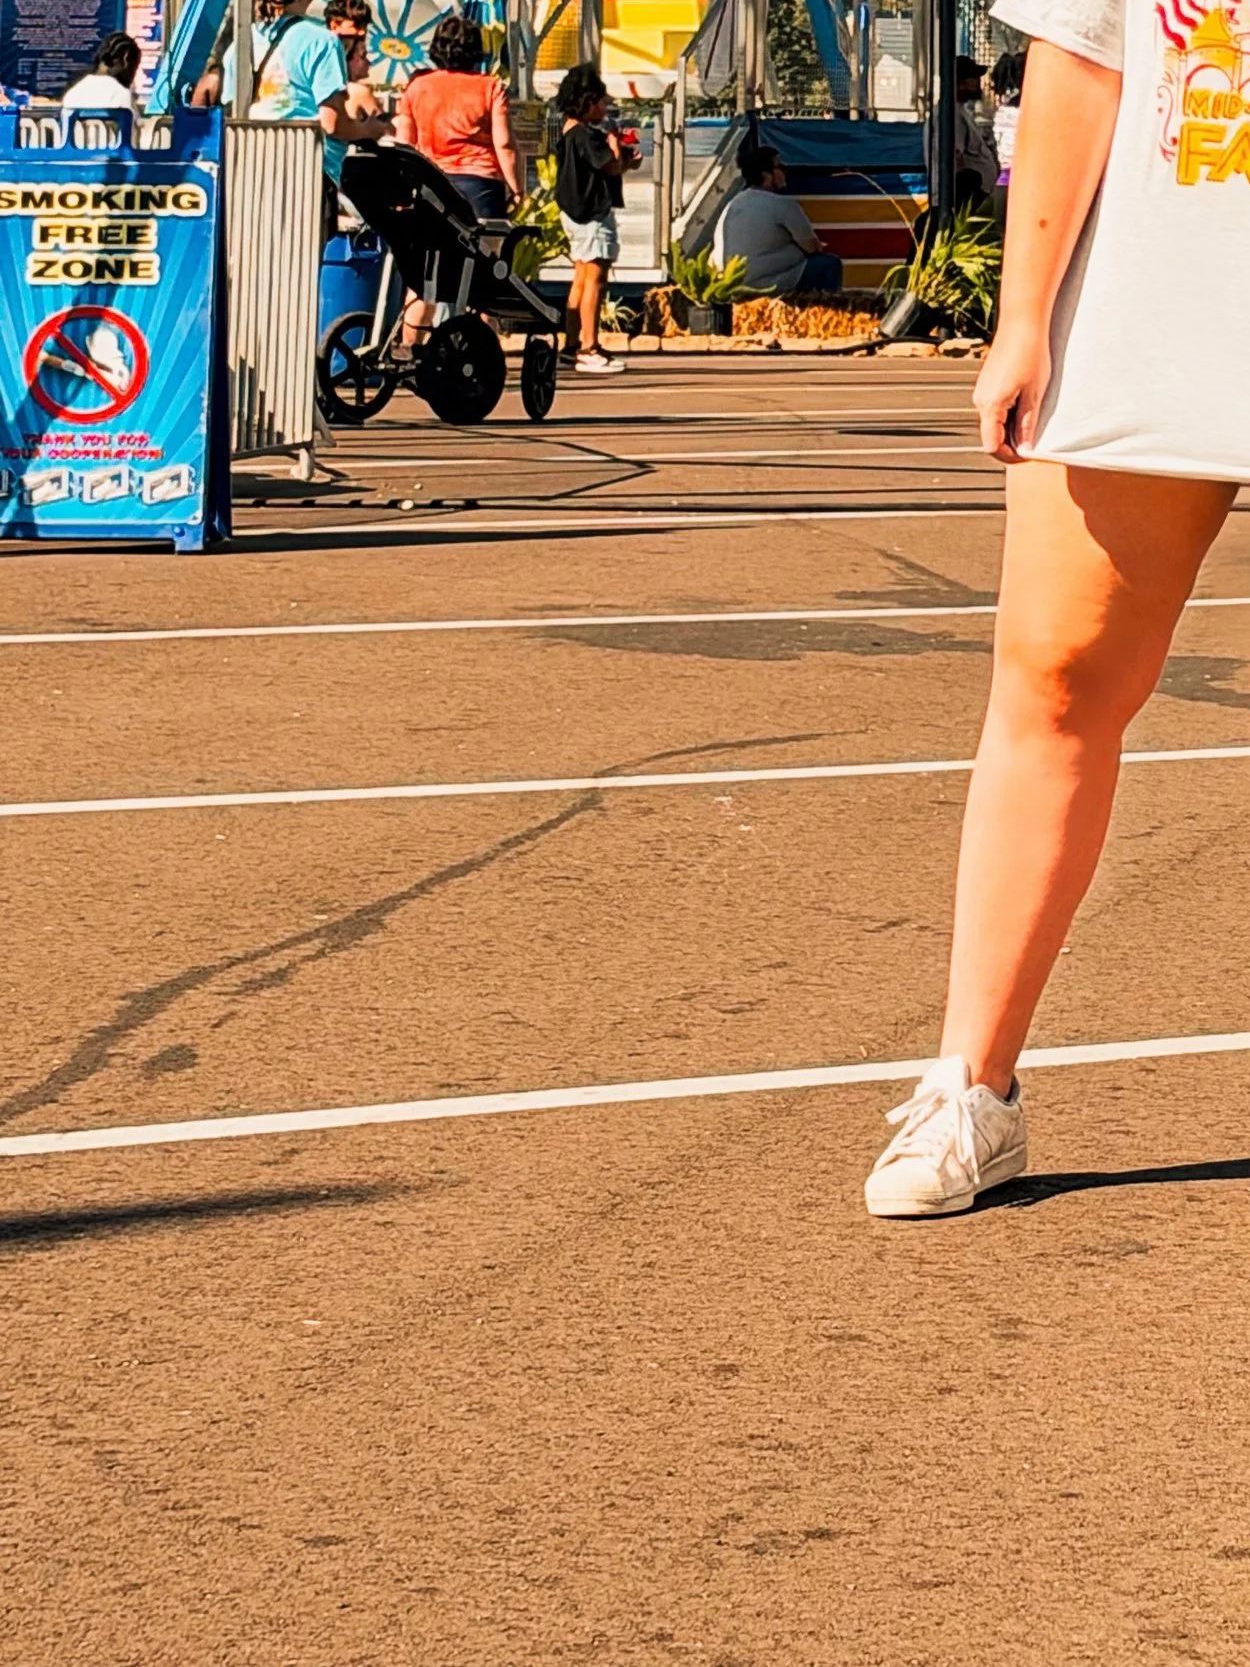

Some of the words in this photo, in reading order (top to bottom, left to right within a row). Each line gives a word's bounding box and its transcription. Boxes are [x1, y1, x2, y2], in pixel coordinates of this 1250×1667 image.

[0, 189, 201, 211] SMOKING
[39, 224, 153, 245] FREE
[32, 259, 155, 280] ZONE
[24, 433, 77, 446] THANK
[81, 433, 112, 446] YOU
